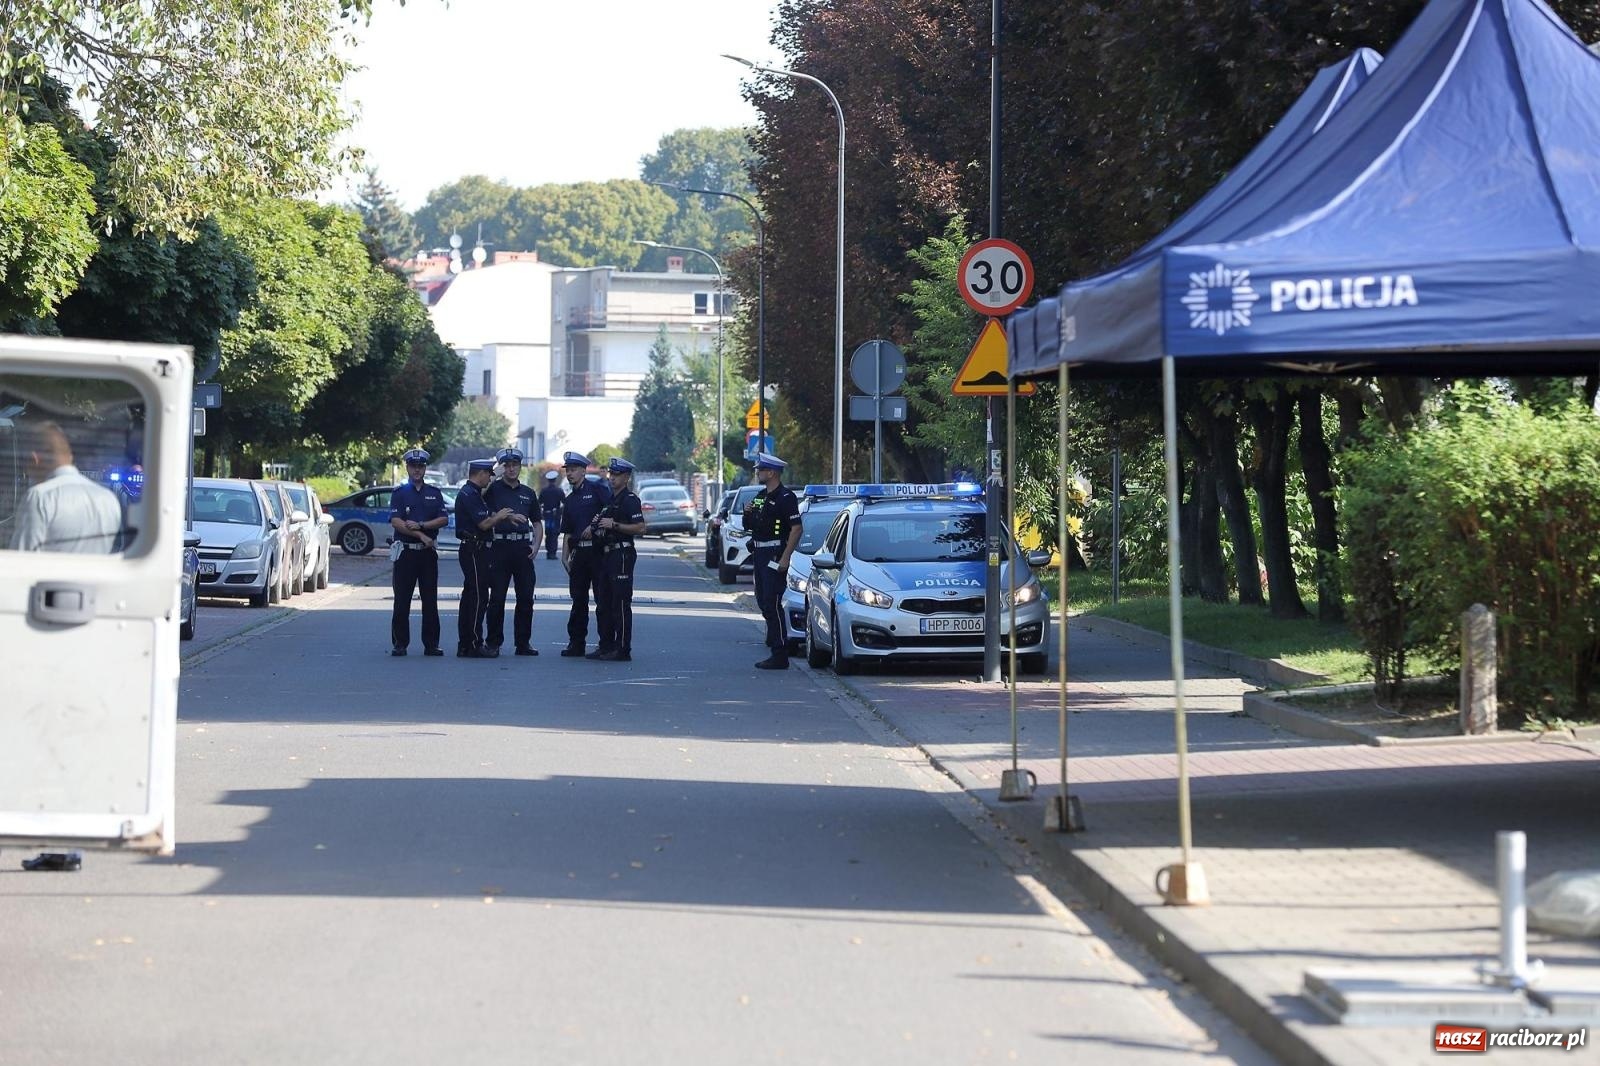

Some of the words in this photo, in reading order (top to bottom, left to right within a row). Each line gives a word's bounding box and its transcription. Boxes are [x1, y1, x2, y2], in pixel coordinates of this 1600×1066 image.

[971, 261, 1023, 294] 30
[1270, 274, 1418, 312] POLICJA
[896, 485, 936, 495] POLICJA
[915, 579, 981, 587] POLICJA
[928, 619, 950, 631] HPP
[953, 619, 981, 630] R006
